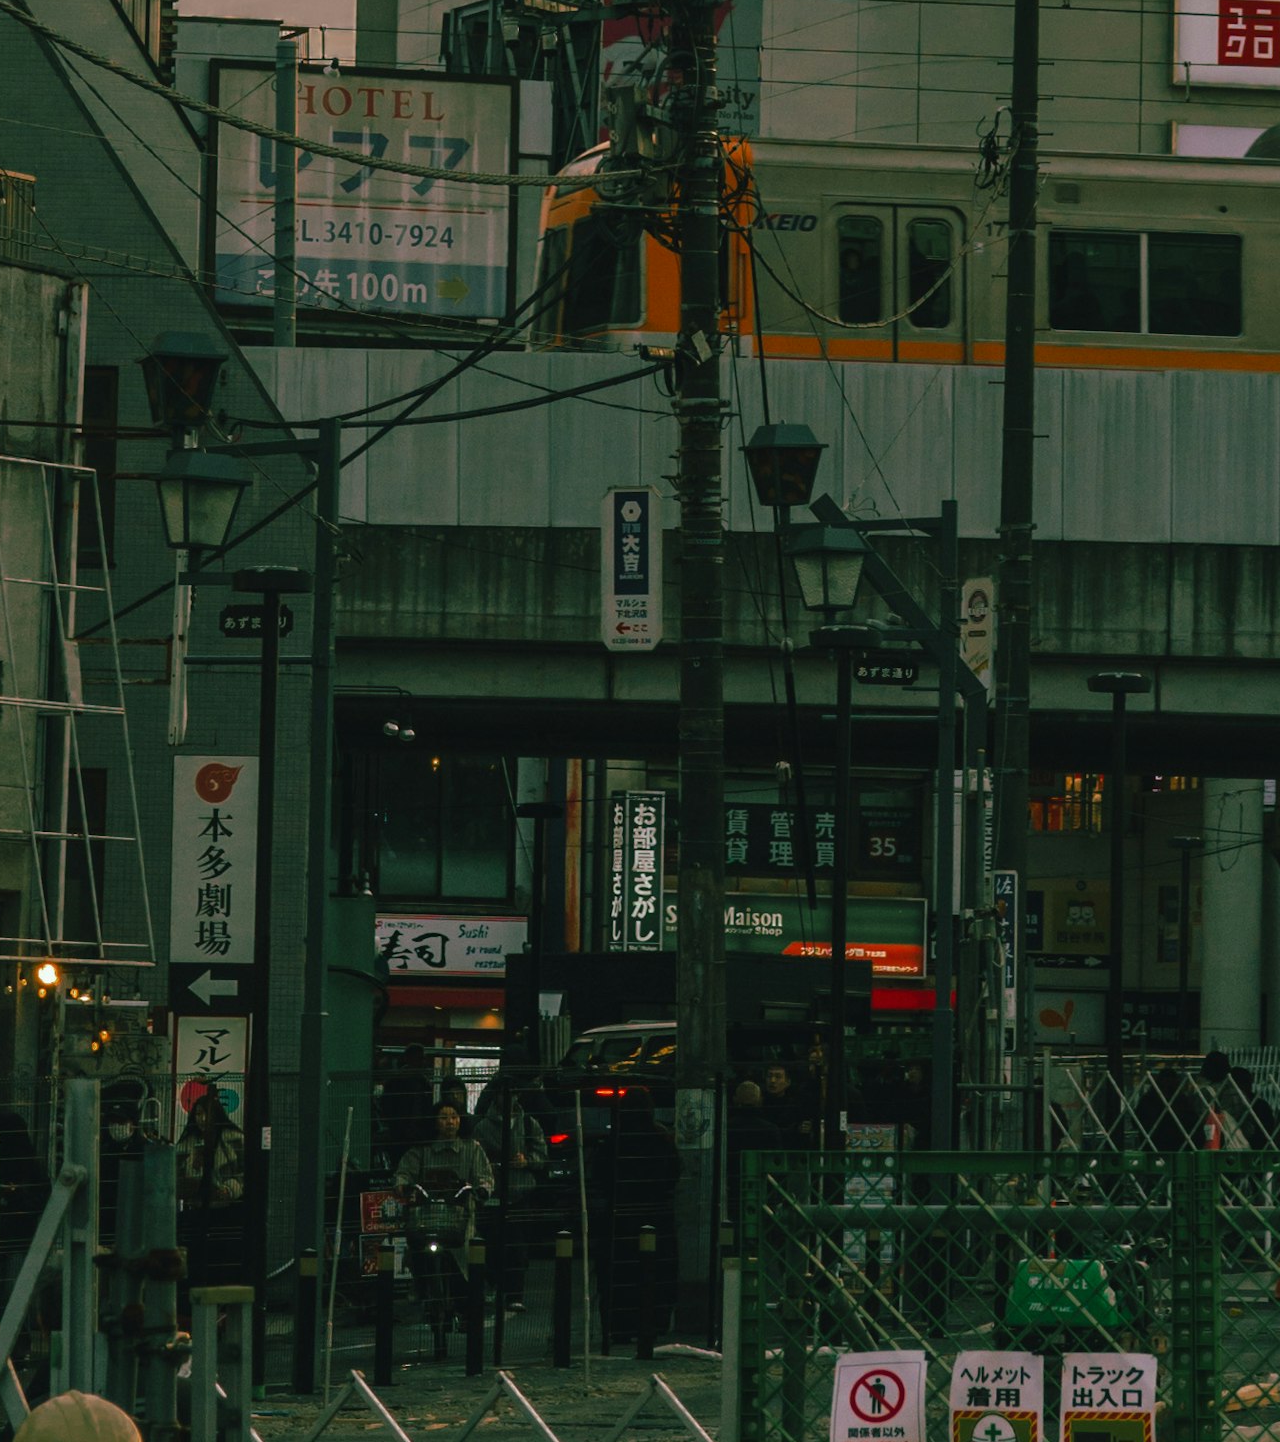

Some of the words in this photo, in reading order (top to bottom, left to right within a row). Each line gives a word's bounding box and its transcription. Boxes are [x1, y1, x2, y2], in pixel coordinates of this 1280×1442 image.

[622, 534, 640, 572] 大吉
[224, 615, 287, 630] あずまり
[770, 811, 795, 867] 管理
[870, 837, 896, 857] 35
[611, 802, 623, 942] お部屋さがし
[631, 803, 657, 942] お部屋さがし
[194, 808, 233, 956] 本多劇場
[724, 907, 783, 928] Maison
[459, 924, 489, 939] Sushi
[755, 927, 783, 937] Shop
[961, 1367, 1031, 1384] ヘルメット
[1072, 1367, 1144, 1385] トラック
[967, 1388, 1020, 1407] 着用
[1072, 1389, 1143, 1407] 出入口
[848, 1426, 905, 1439] 関係者以外
